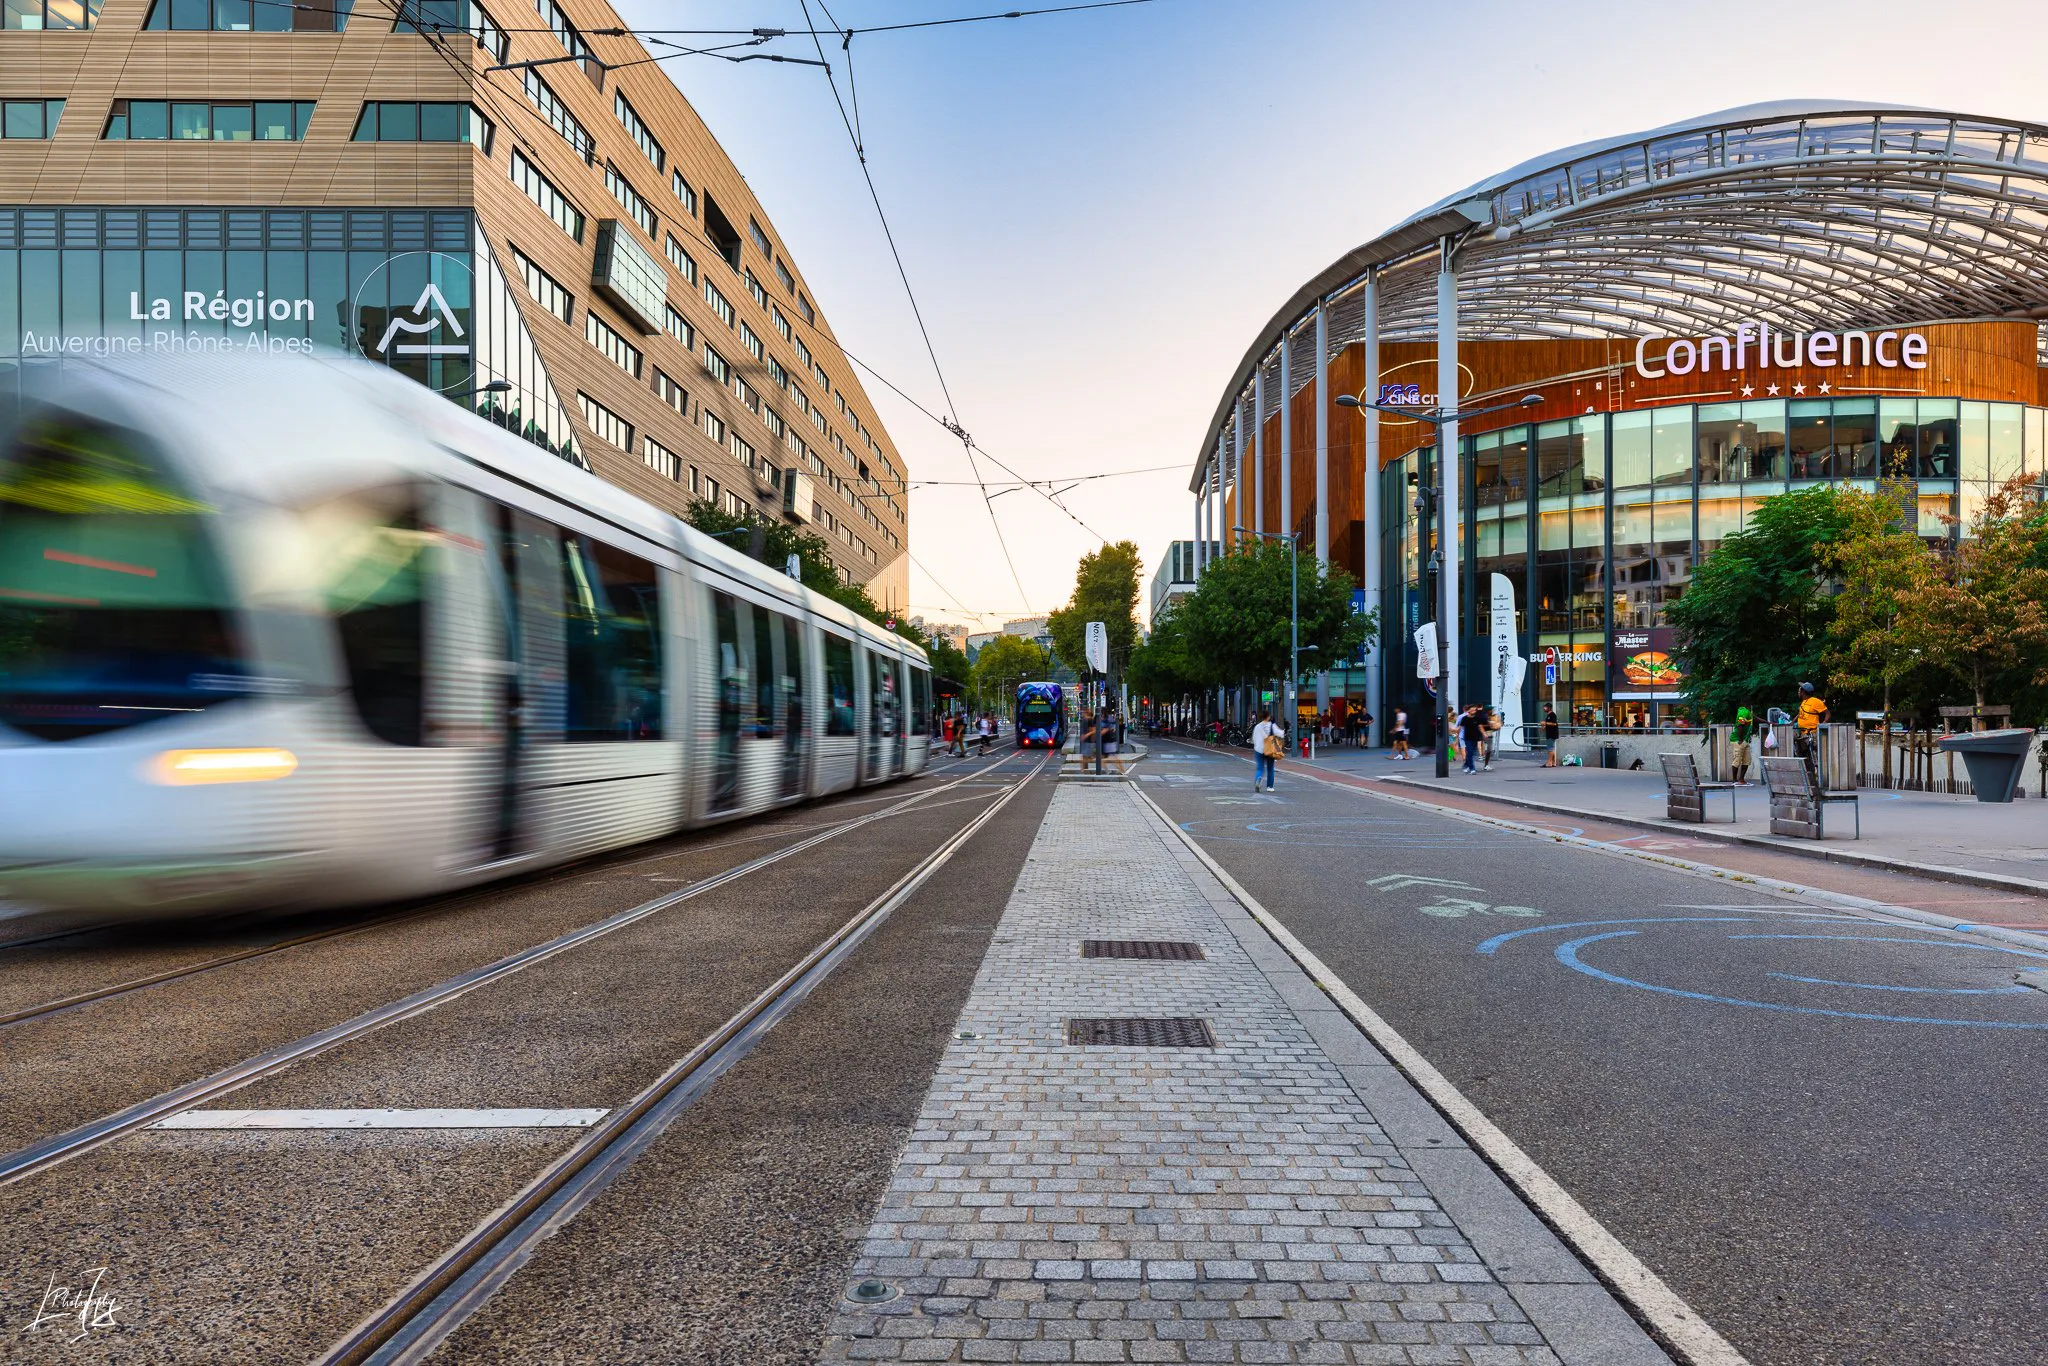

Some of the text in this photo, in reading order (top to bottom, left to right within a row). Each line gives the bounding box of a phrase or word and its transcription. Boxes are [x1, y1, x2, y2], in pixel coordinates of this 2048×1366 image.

[130, 290, 315, 327] La Région
[21, 329, 314, 357] Auvergne-Rhône-Alpes
[1635, 321, 1928, 379] Confluence
[1389, 393, 1440, 405] CINÉ CIT
[1615, 636, 1648, 645] Master
[1529, 652, 1602, 663] BUER KING
